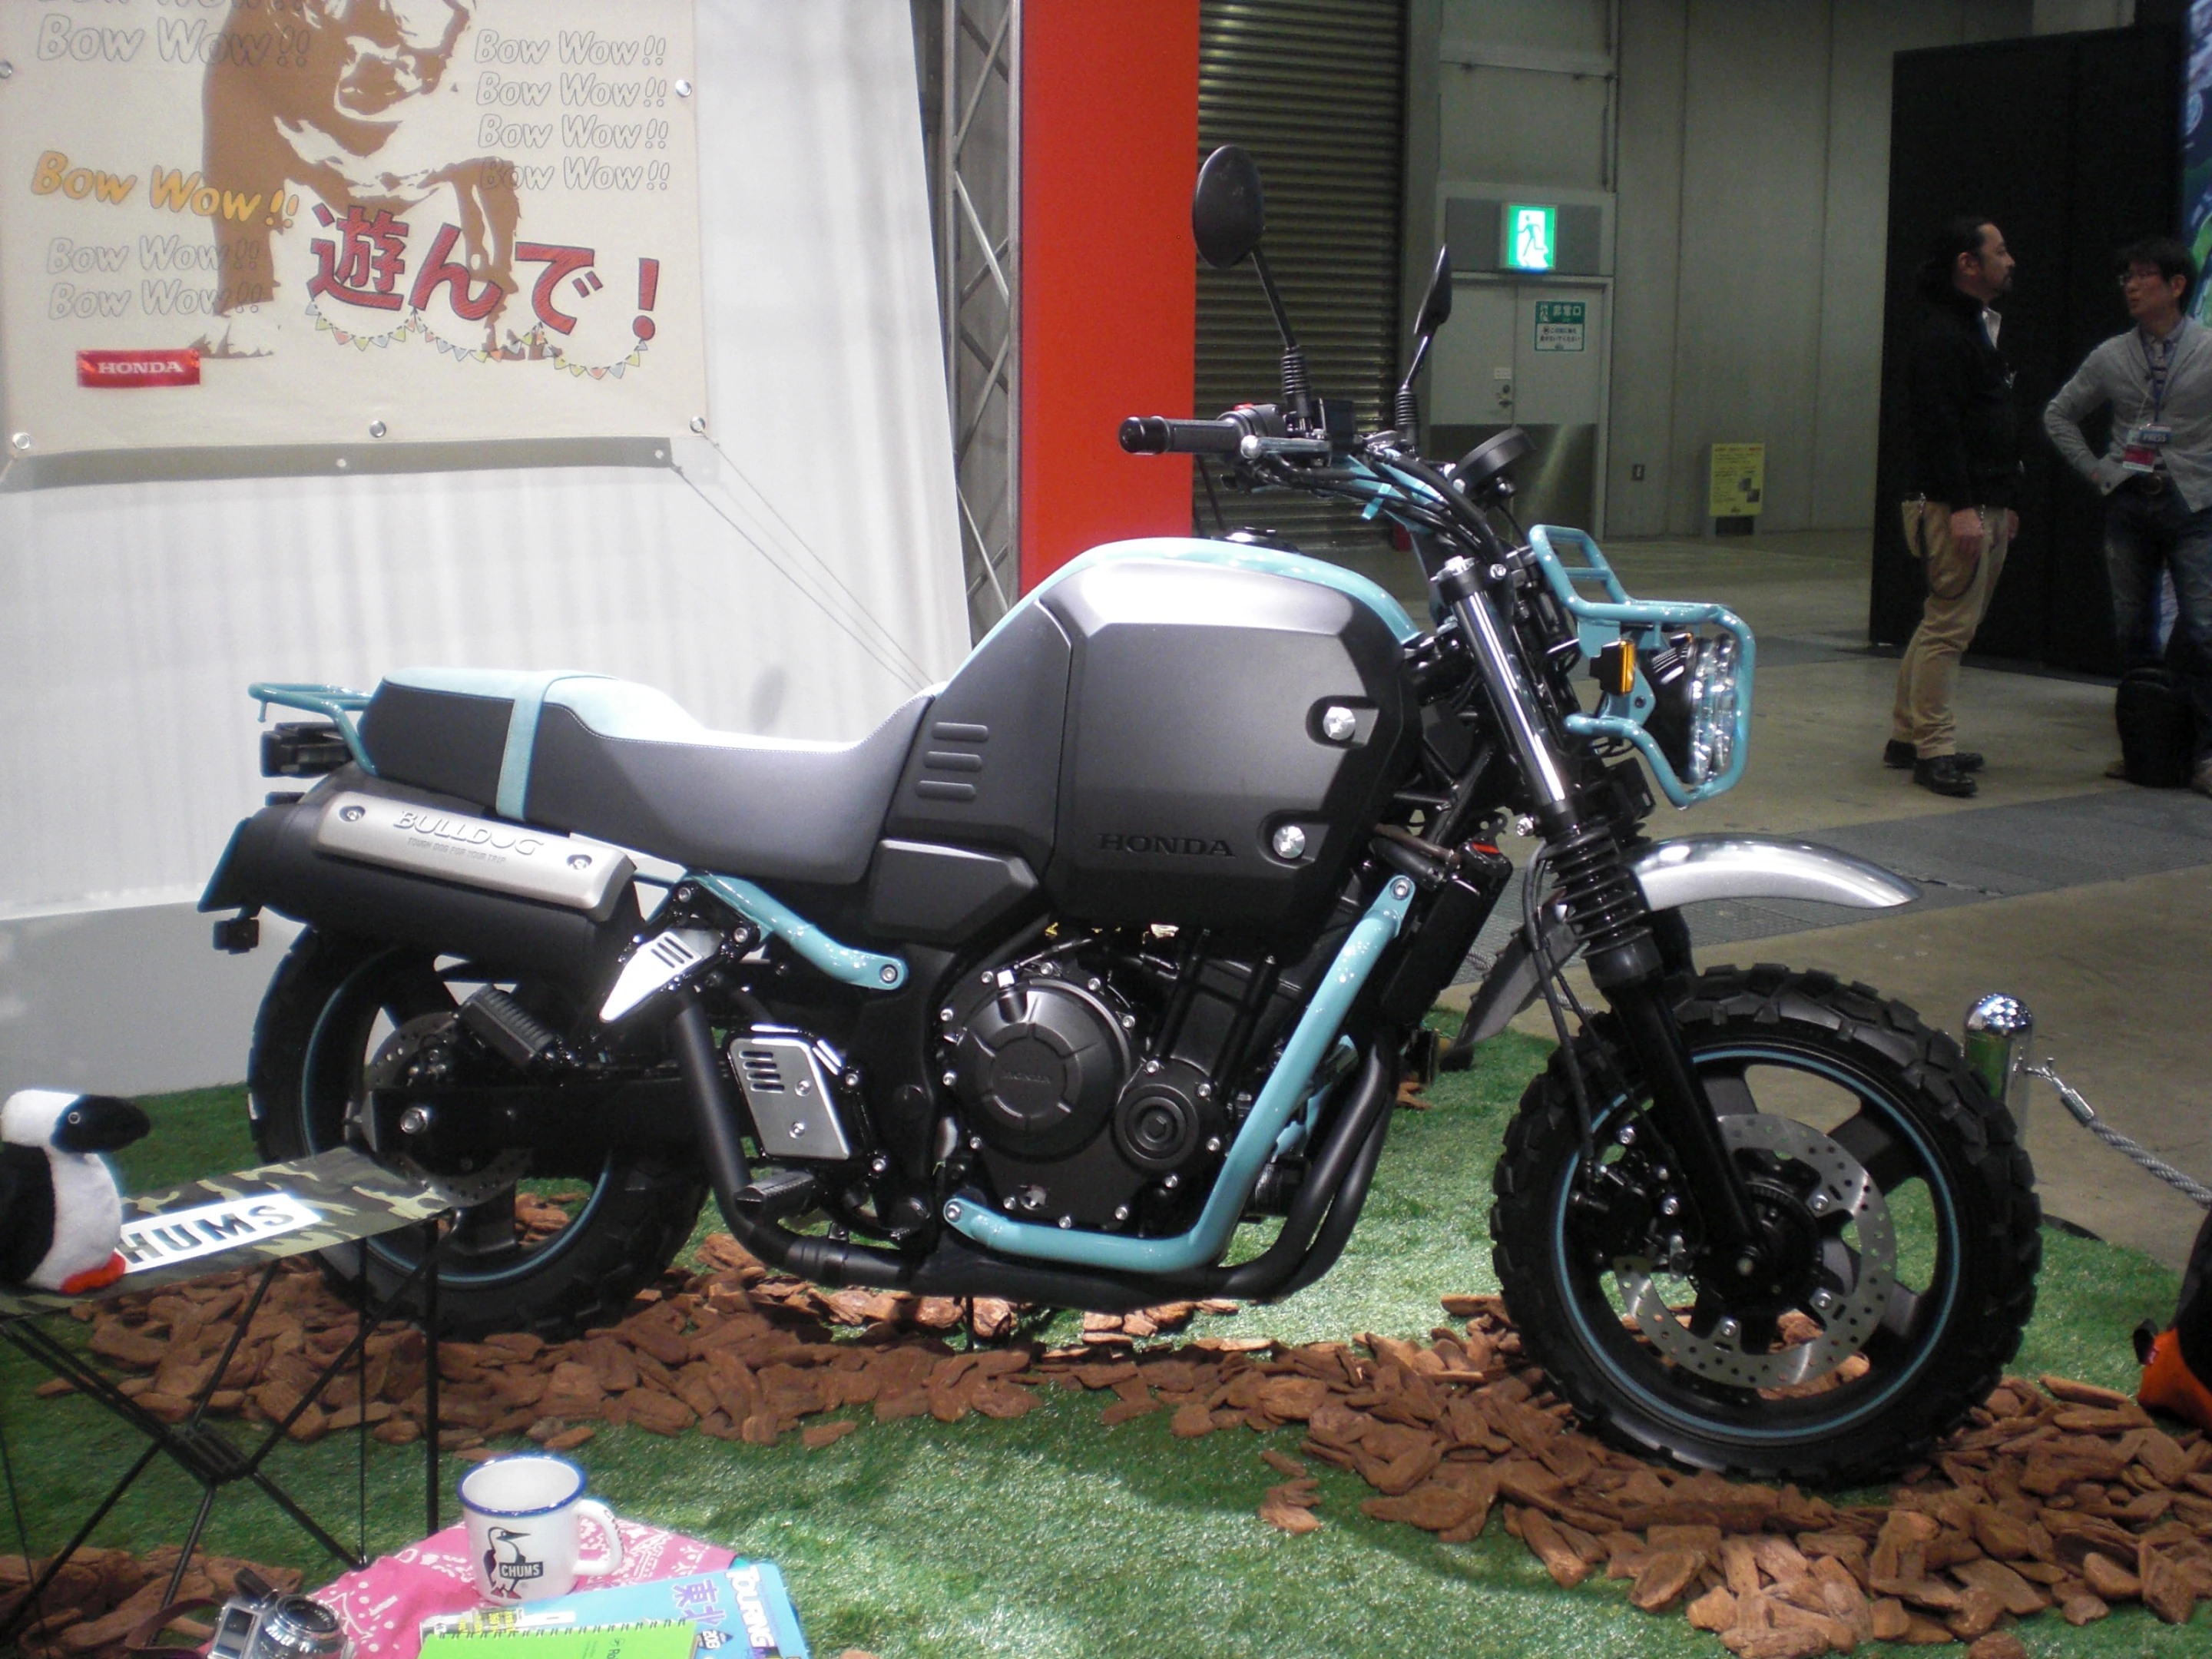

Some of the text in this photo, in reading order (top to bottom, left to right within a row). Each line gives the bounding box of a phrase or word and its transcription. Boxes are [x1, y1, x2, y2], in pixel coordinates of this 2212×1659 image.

[36, 13, 145, 62] Bow
[475, 28, 550, 65] Bow
[476, 71, 551, 106] Bow
[478, 114, 553, 148] Bow
[31, 150, 138, 205] Bow
[46, 237, 129, 274] Bow
[48, 282, 131, 320] Bow
[98, 361, 184, 375] HONDA
[393, 811, 545, 856] BULLDOG
[407, 837, 507, 864] TOUGH DOG FOR YOUR TRIP
[1096, 833, 1237, 859] HONDA
[117, 1204, 295, 1264] HUMS
[501, 1564, 541, 1578] CHUMS
[671, 1579, 727, 1627] 東北
